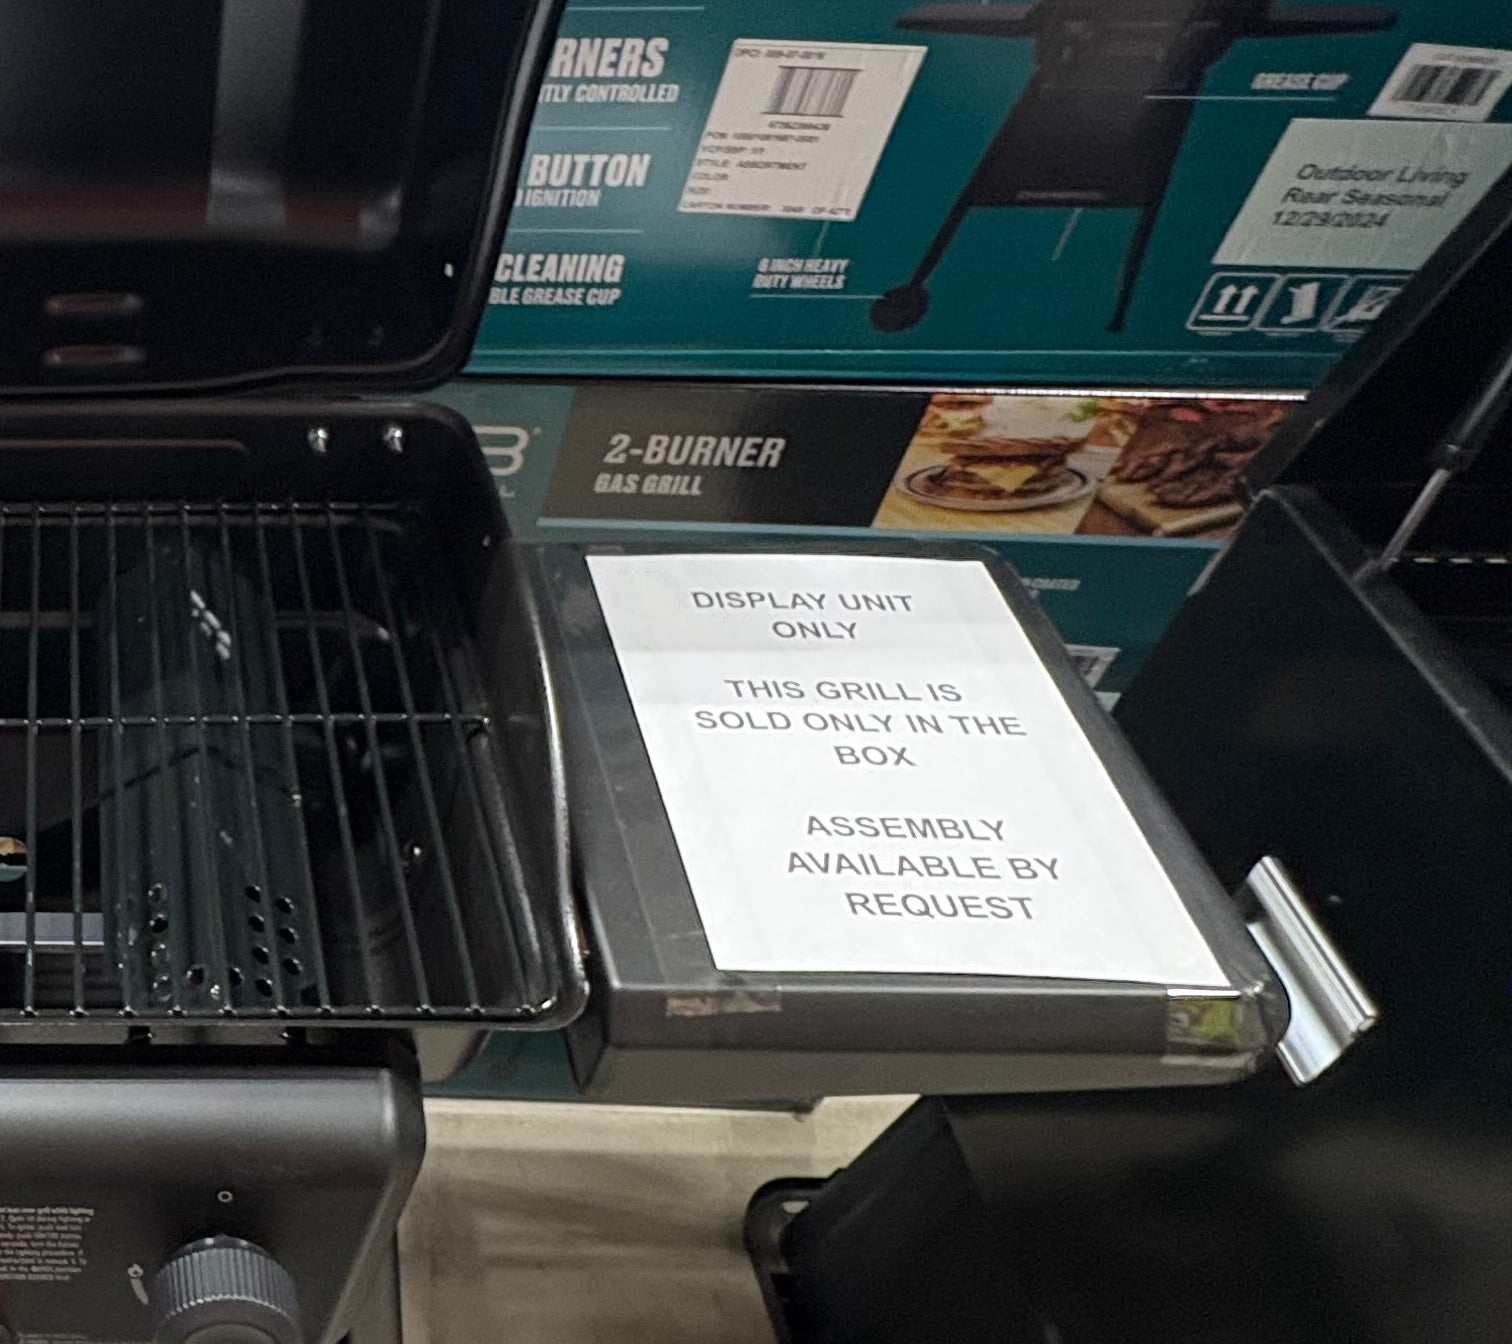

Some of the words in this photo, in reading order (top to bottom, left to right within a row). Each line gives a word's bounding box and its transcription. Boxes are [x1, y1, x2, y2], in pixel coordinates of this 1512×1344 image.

[548, 37, 670, 78] RNERS
[574, 84, 680, 103] CONTROLLED
[526, 153, 652, 188] BUTTON
[1296, 163, 1392, 182] Outdoor
[1396, 164, 1470, 189] Living
[523, 188, 603, 208] IGNITION
[1281, 187, 1339, 204] Rear
[1340, 188, 1452, 207] Seasonal
[494, 252, 626, 283] CLEANING
[521, 287, 587, 306] GREASE
[585, 288, 623, 307] CUP
[603, 432, 787, 469] 2-BURNER
[593, 472, 640, 494] GAS
[641, 474, 703, 497] GRILL
[691, 591, 828, 610] DISPLAY
[838, 593, 913, 613] UNIT
[771, 620, 859, 640] ONLY
[724, 678, 806, 700] THIS
[815, 680, 922, 703] GRILL
[926, 683, 964, 703] IS
[694, 710, 793, 732] SOLD
[802, 712, 893, 734] ONLY
[903, 714, 943, 735] IN
[947, 715, 1029, 737] THE
[833, 744, 919, 767] BOX
[806, 815, 1006, 842] ASSEMBLY
[787, 851, 1002, 881] AVAILABLE
[1006, 857, 1061, 882] BY
[844, 892, 1035, 921] REQUEST
